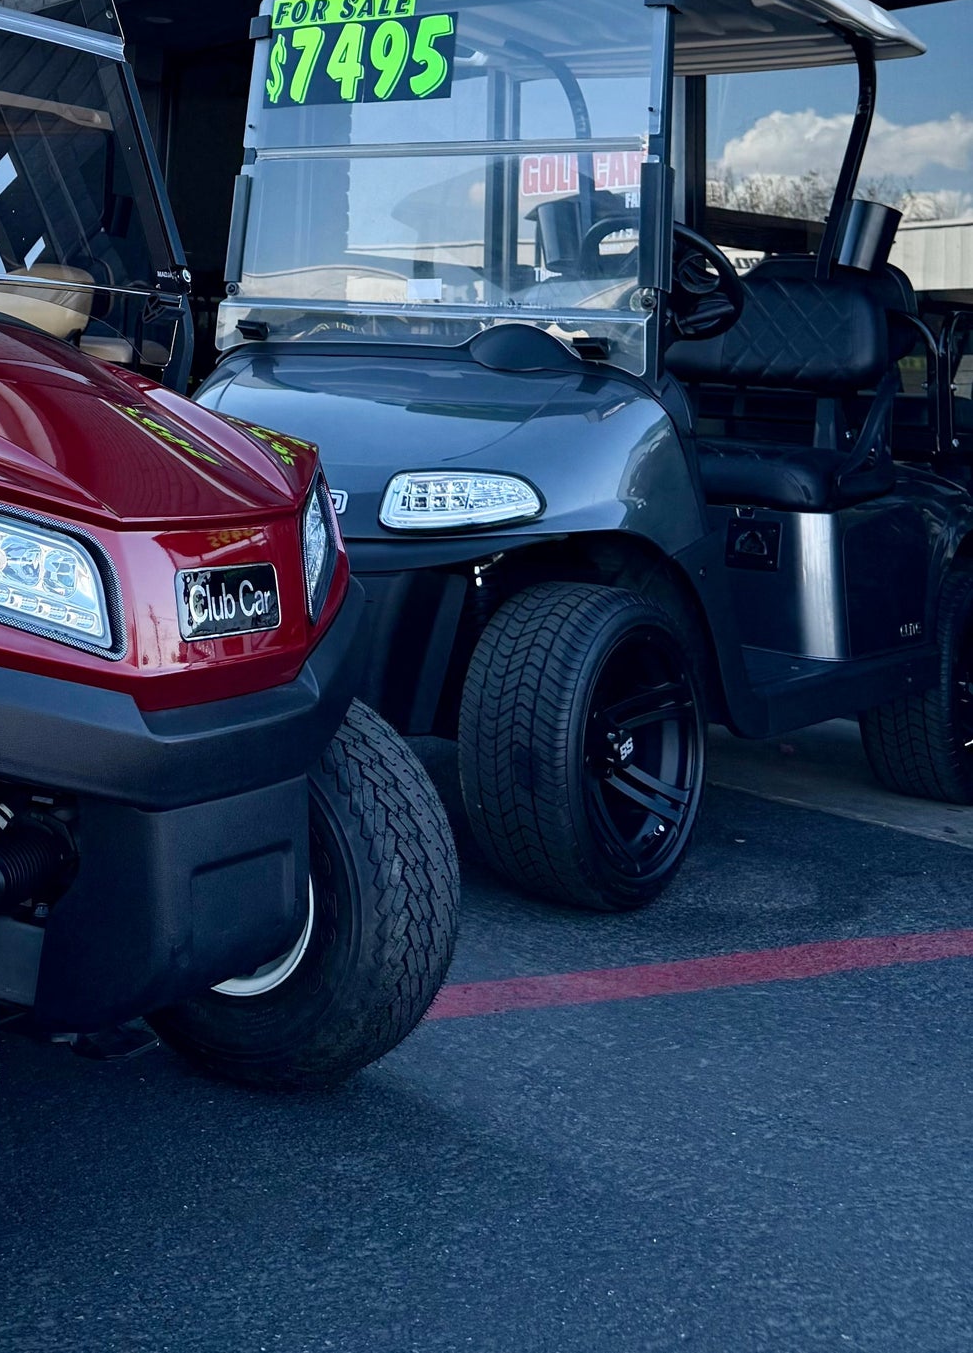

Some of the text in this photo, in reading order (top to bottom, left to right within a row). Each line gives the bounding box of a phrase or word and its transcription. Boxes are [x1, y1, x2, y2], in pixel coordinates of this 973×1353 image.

[274, 0, 330, 26] FOR
[266, 14, 454, 104] $7495
[188, 579, 271, 623] Club Car
